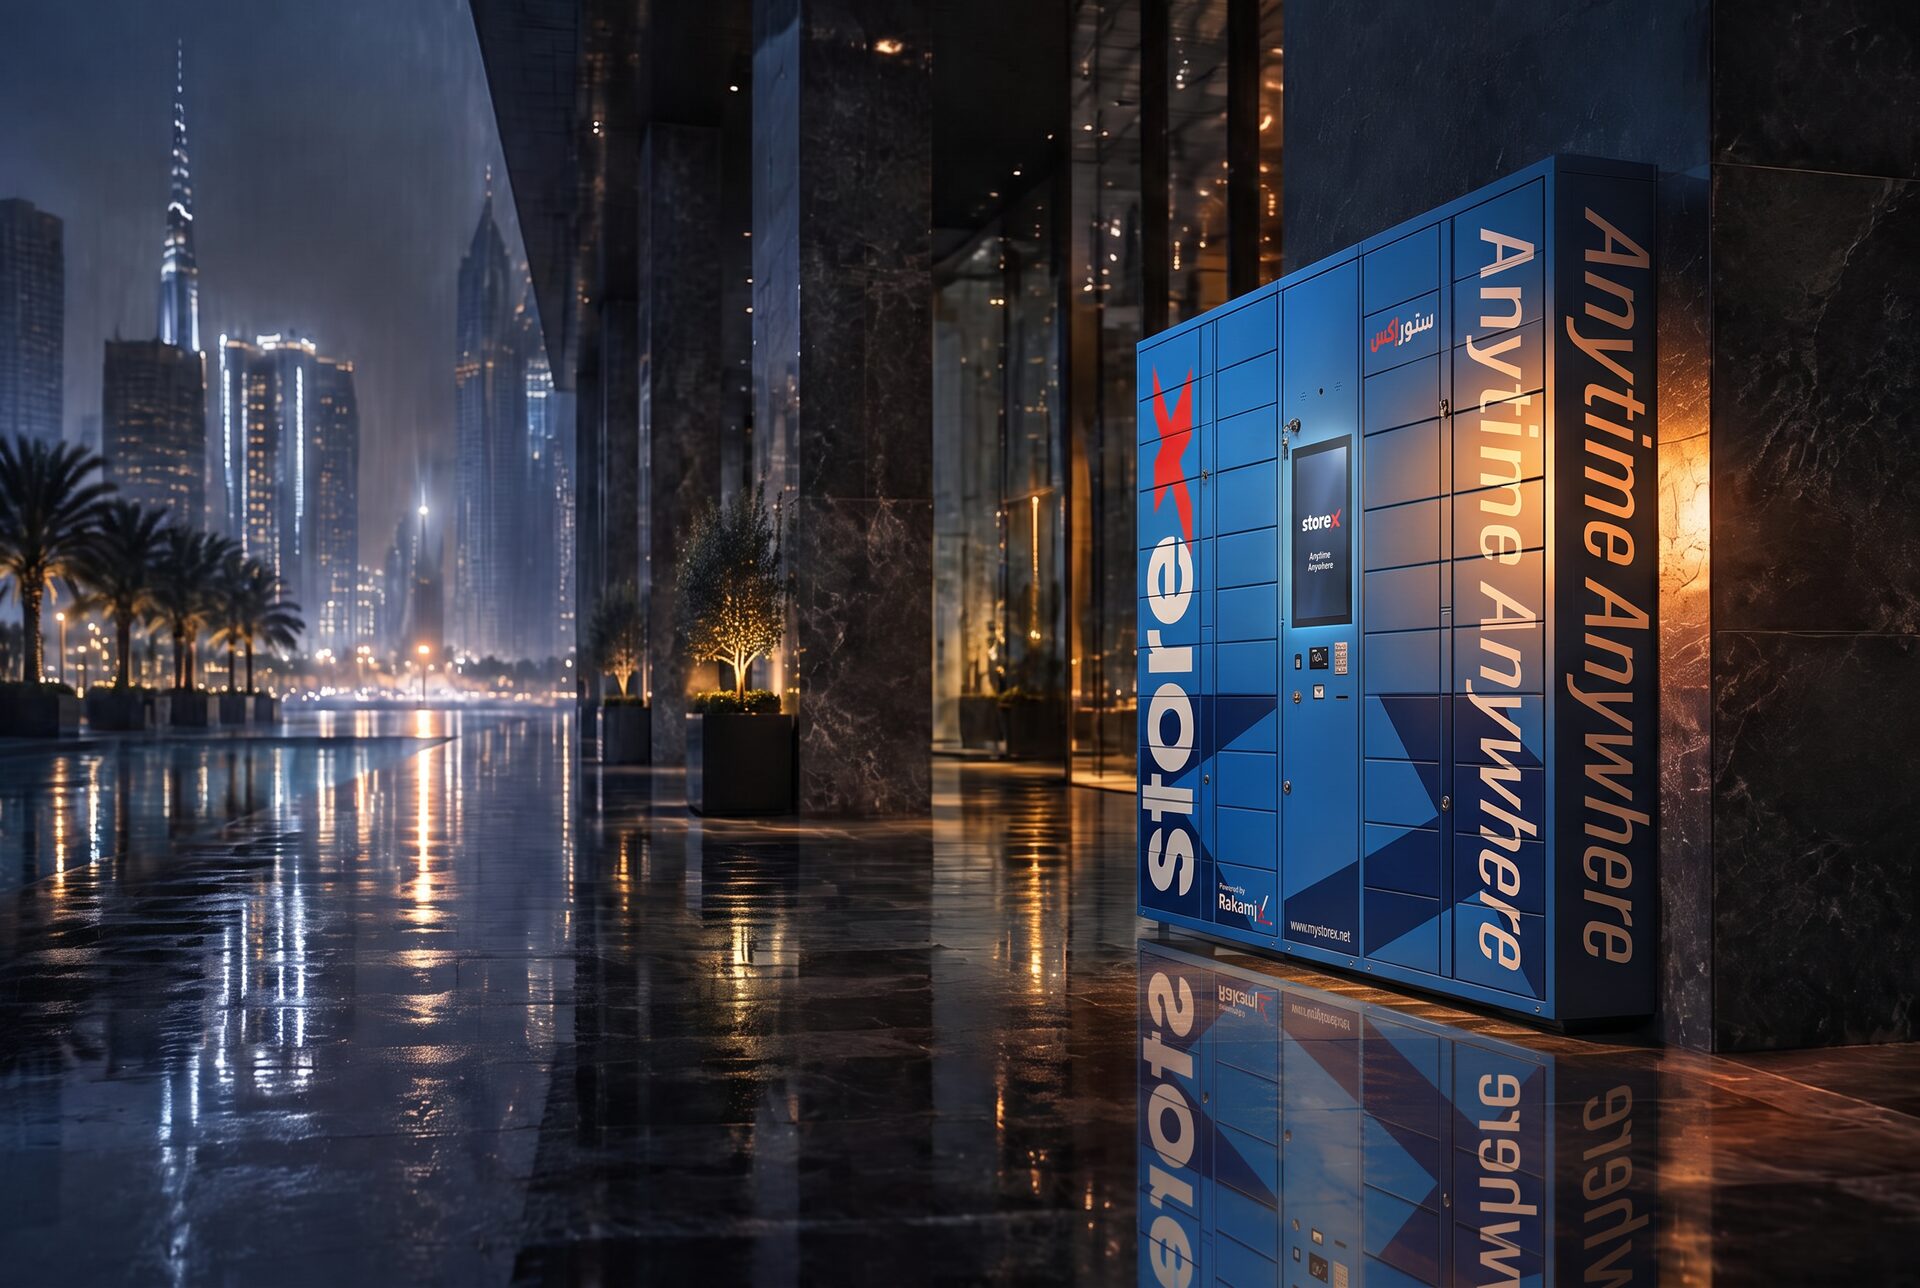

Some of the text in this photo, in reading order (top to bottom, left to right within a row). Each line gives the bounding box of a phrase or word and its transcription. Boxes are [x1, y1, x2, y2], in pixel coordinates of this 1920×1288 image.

[1309, 551, 1331, 561] Anytime
[1566, 207, 1652, 964] Anytime Anywhere
[1465, 228, 1539, 971] Anytime Anywhere
[1239, 886, 1245, 895] by
[1290, 920, 1351, 943] www.mystorex.net
